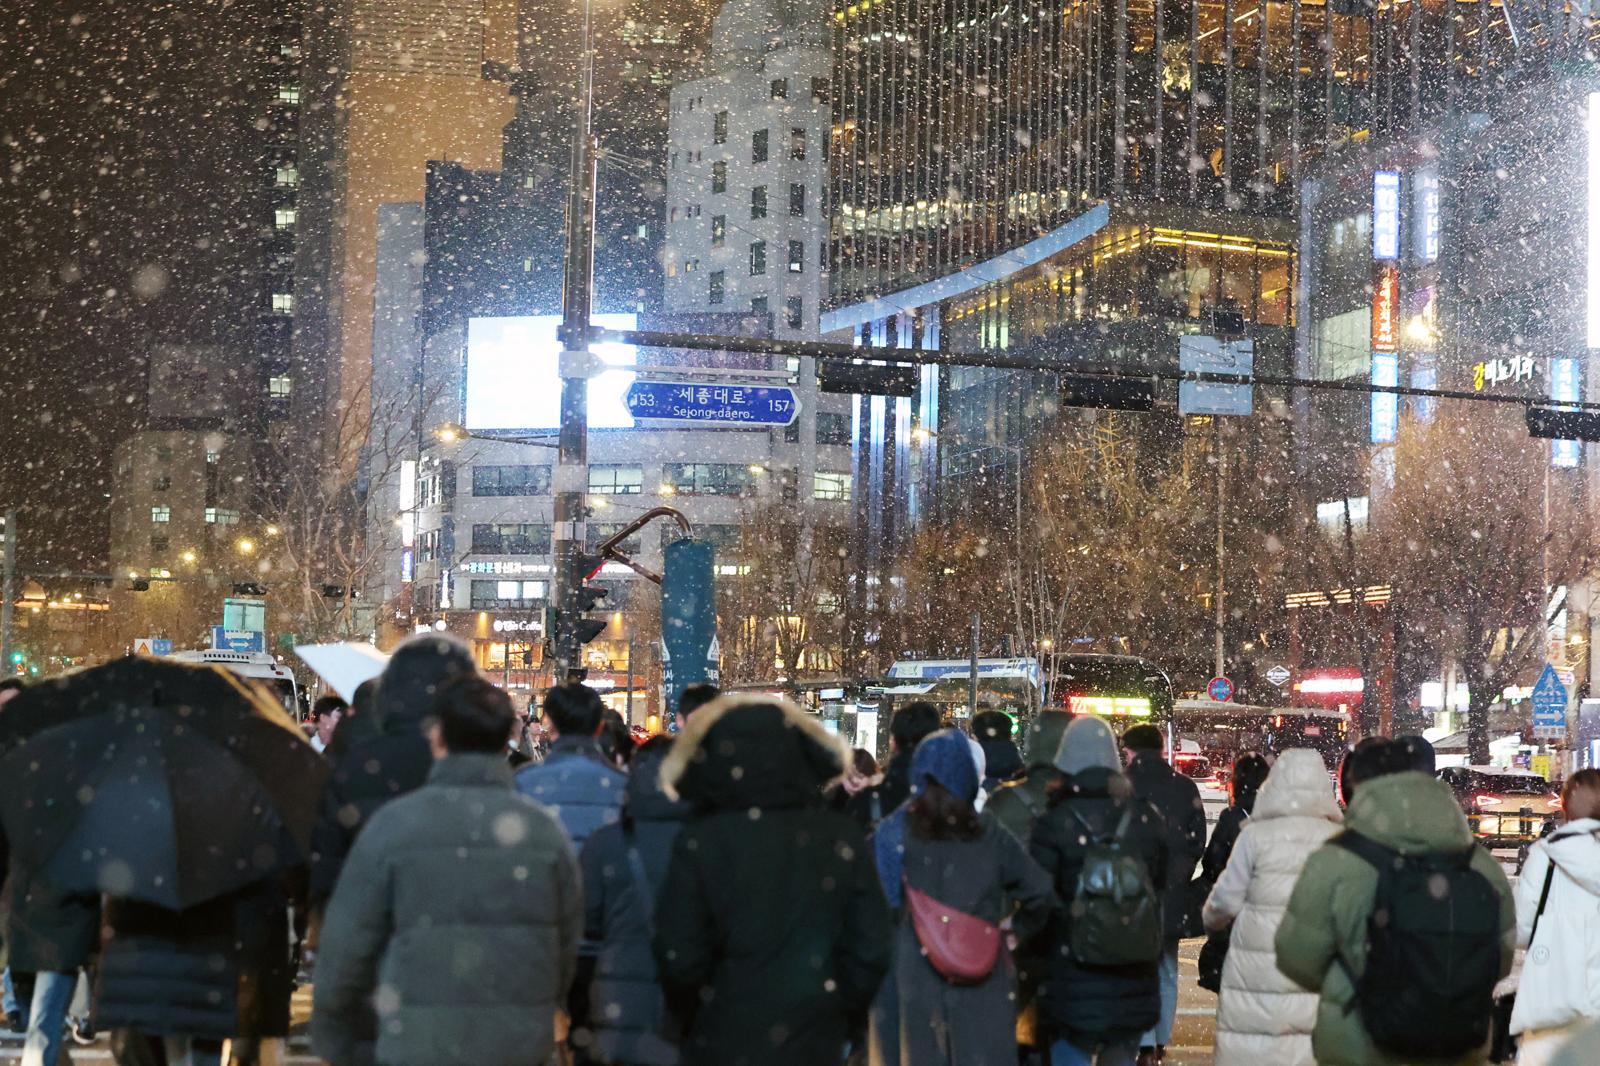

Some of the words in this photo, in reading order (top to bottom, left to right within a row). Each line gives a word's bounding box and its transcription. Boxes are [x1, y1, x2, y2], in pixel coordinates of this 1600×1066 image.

[633, 394, 655, 407] 153
[679, 387, 746, 405] 세종대로
[673, 405, 750, 419] Sejong-daero
[768, 399, 790, 412] 157
[519, 620, 543, 631] Coffe
